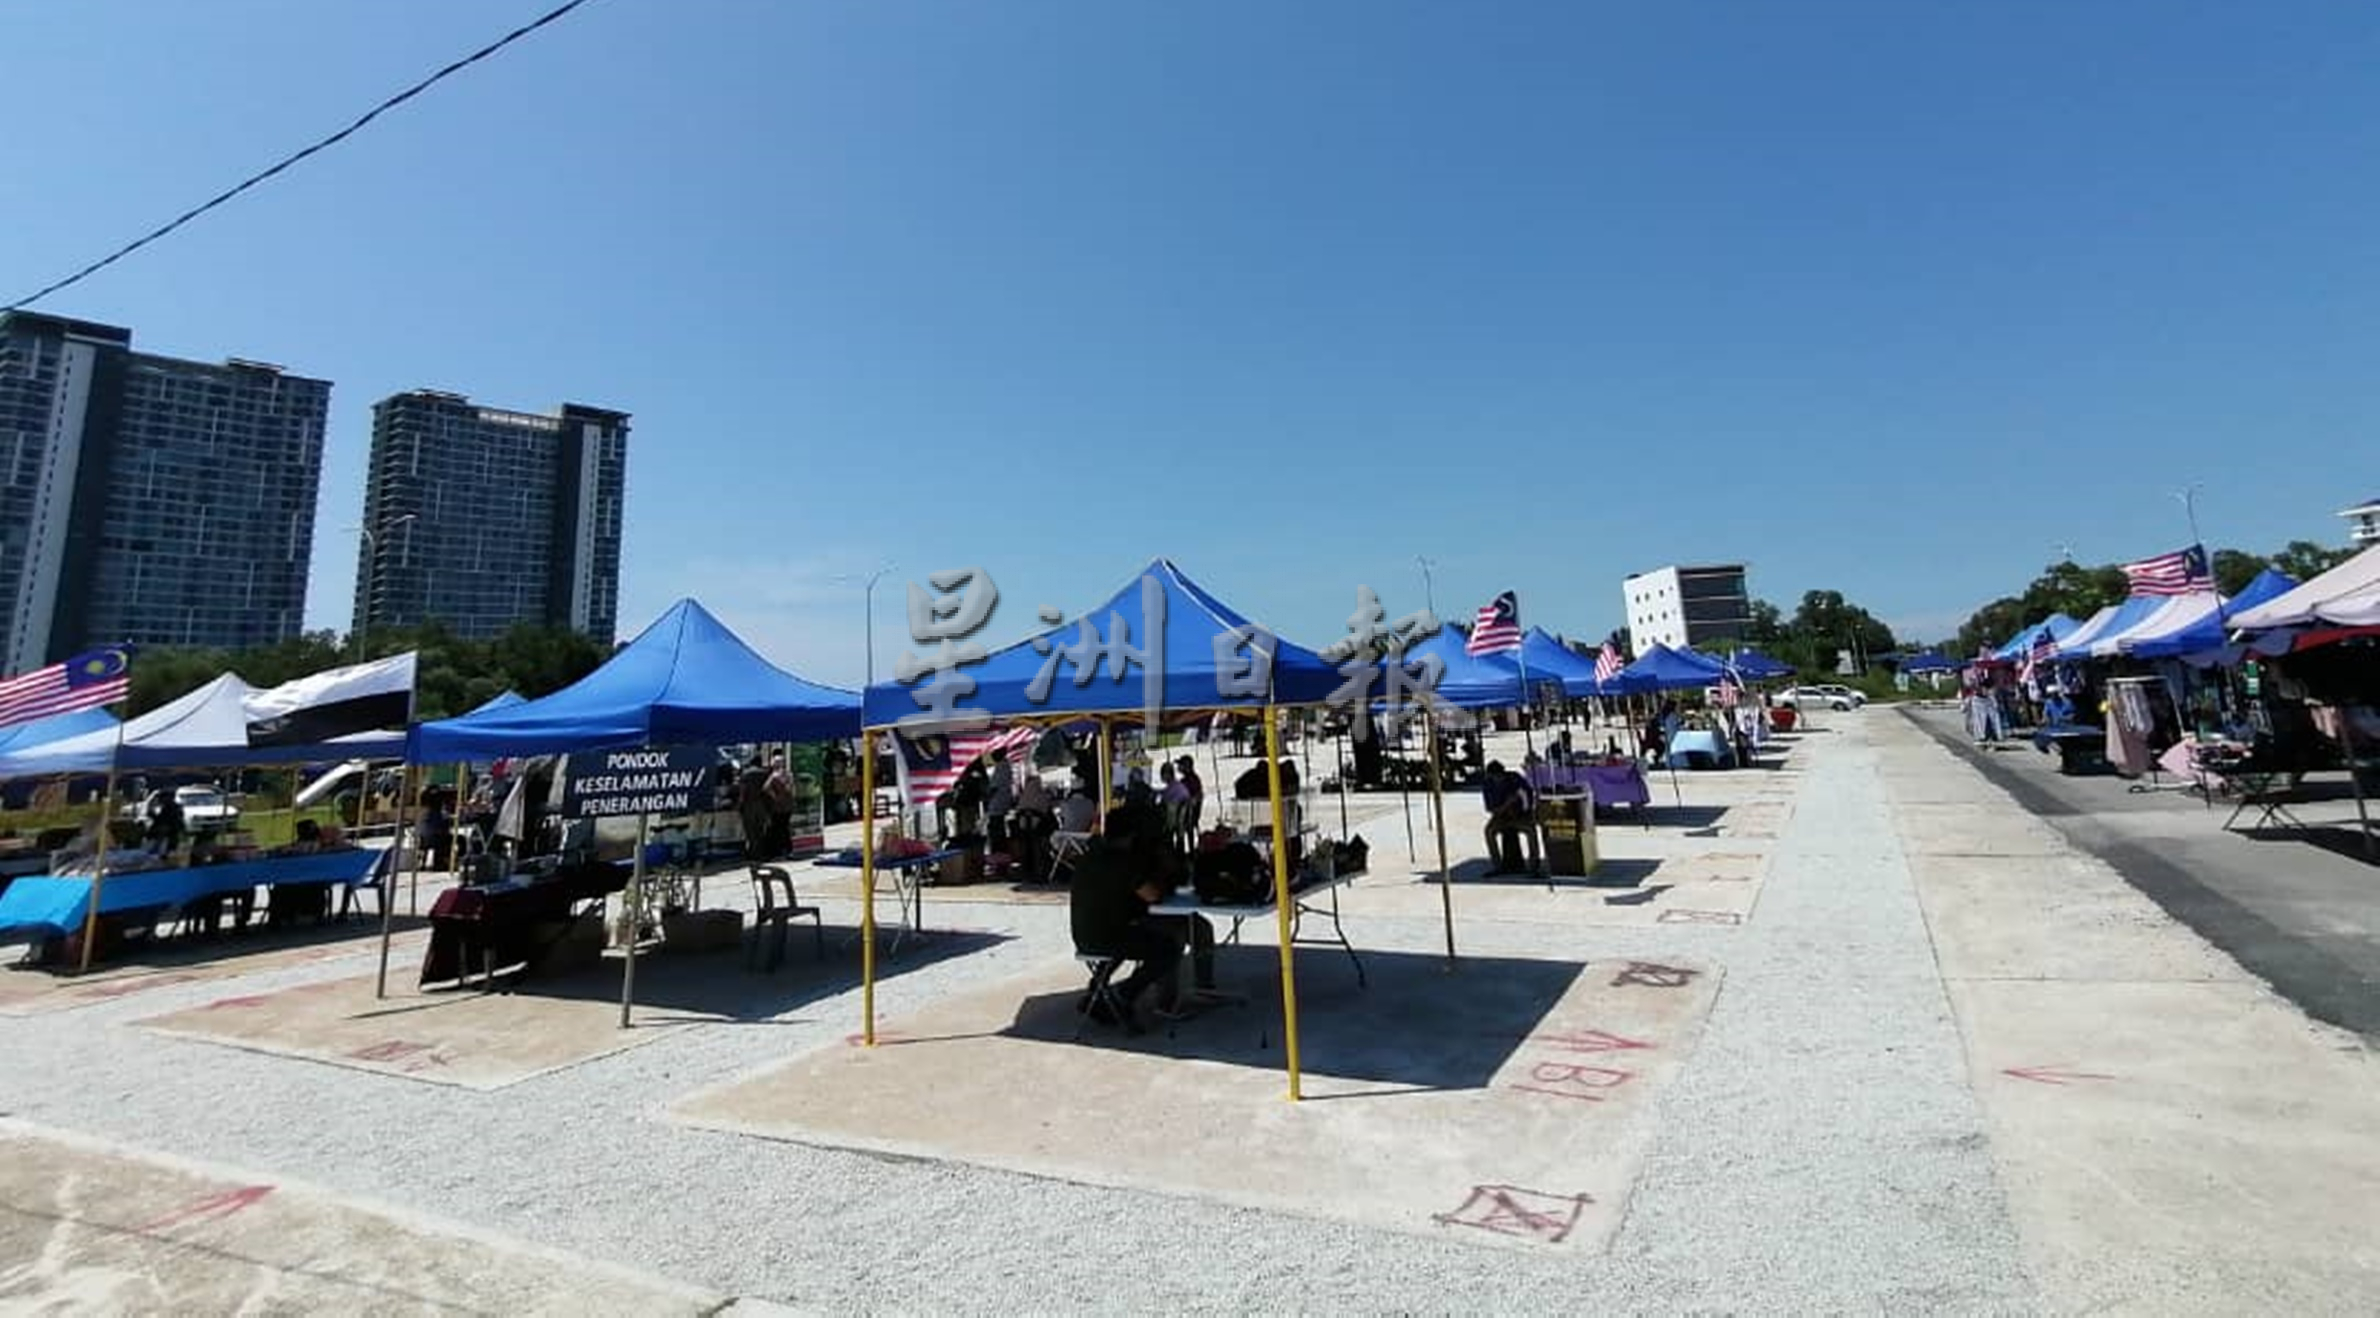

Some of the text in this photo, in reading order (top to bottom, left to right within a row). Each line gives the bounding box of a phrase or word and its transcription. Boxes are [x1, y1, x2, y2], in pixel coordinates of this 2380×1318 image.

[607, 752, 669, 769] PONDOK
[575, 771, 691, 793] KESELAMATAN
[581, 793, 688, 815] PENERANGAN
